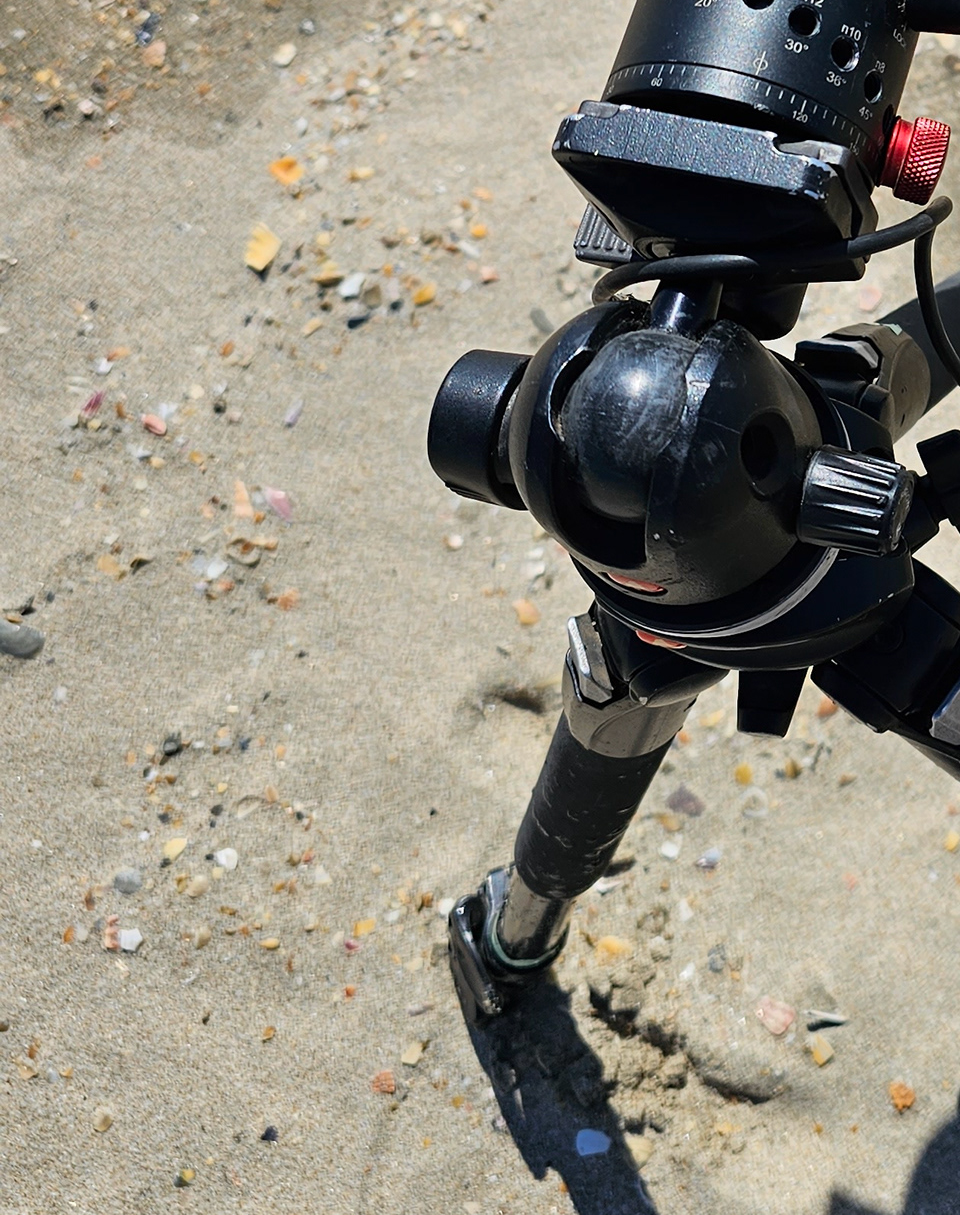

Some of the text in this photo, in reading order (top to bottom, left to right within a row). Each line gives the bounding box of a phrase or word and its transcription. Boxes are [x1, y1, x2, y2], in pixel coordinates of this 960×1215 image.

[841, 22, 862, 42] n10
[650, 76, 663, 87] 60
[791, 109, 809, 124] 120
